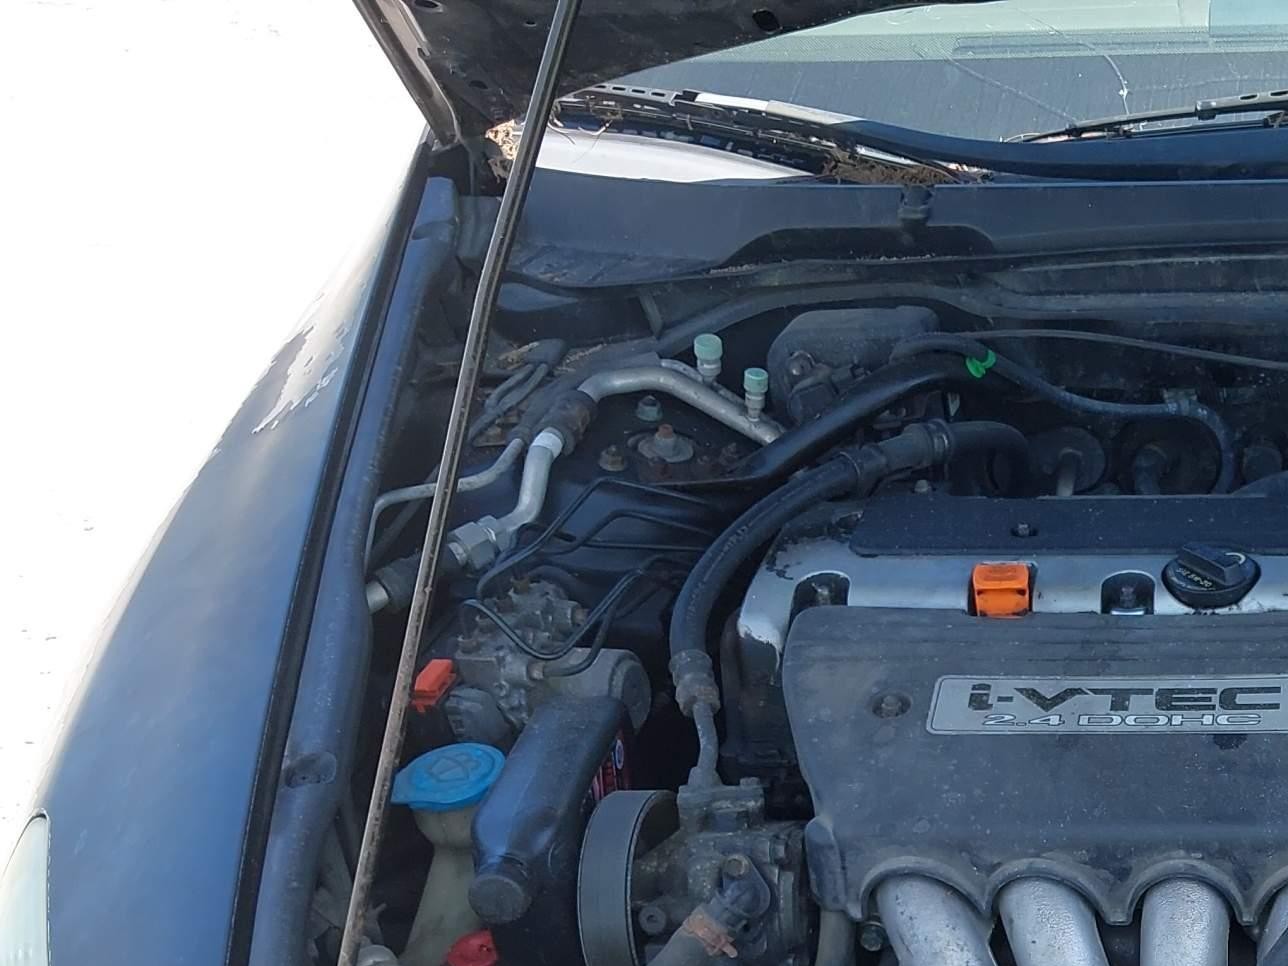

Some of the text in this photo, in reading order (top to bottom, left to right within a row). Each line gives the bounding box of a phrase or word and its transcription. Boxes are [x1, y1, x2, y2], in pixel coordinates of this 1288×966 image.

[968, 684, 1281, 712] i-VTEC
[982, 713, 1262, 727] 2.4 DOHC
